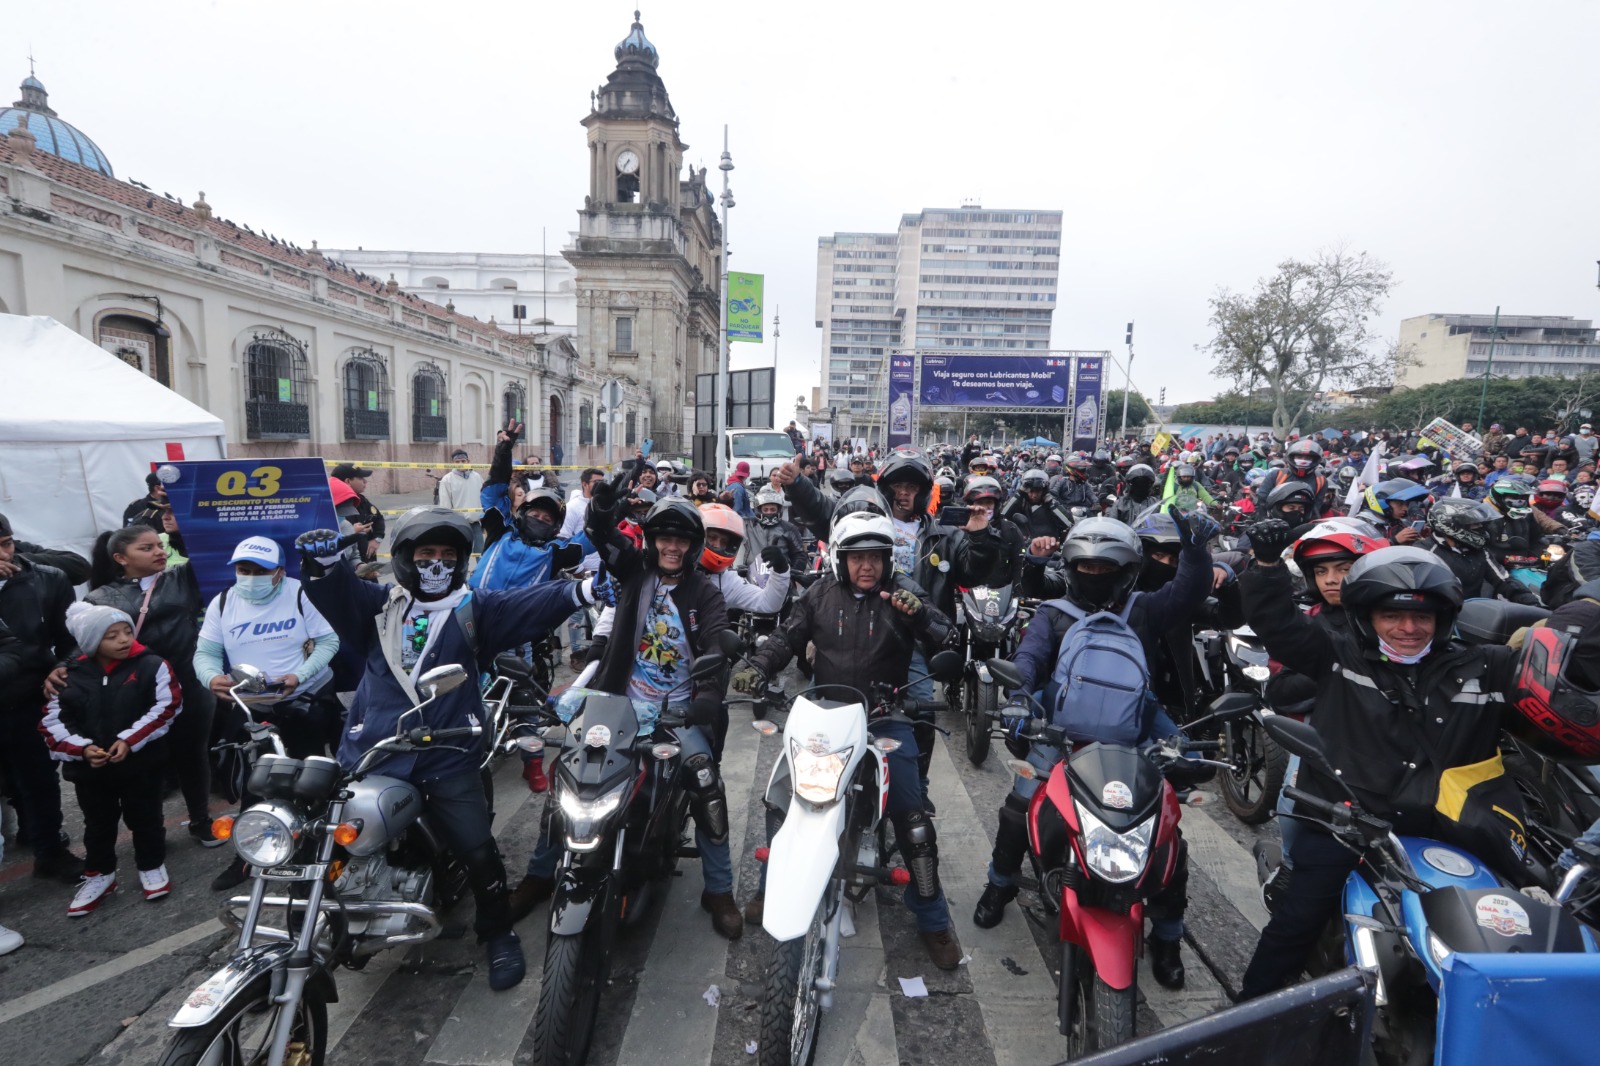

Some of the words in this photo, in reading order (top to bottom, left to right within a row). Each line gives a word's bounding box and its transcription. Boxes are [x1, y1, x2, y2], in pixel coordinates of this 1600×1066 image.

[933, 370, 950, 380] Viaja
[1016, 381, 1034, 390] viaje.
[216, 466, 282, 497] Q3
[248, 544, 272, 553] UNO
[252, 618, 296, 636] UNO
